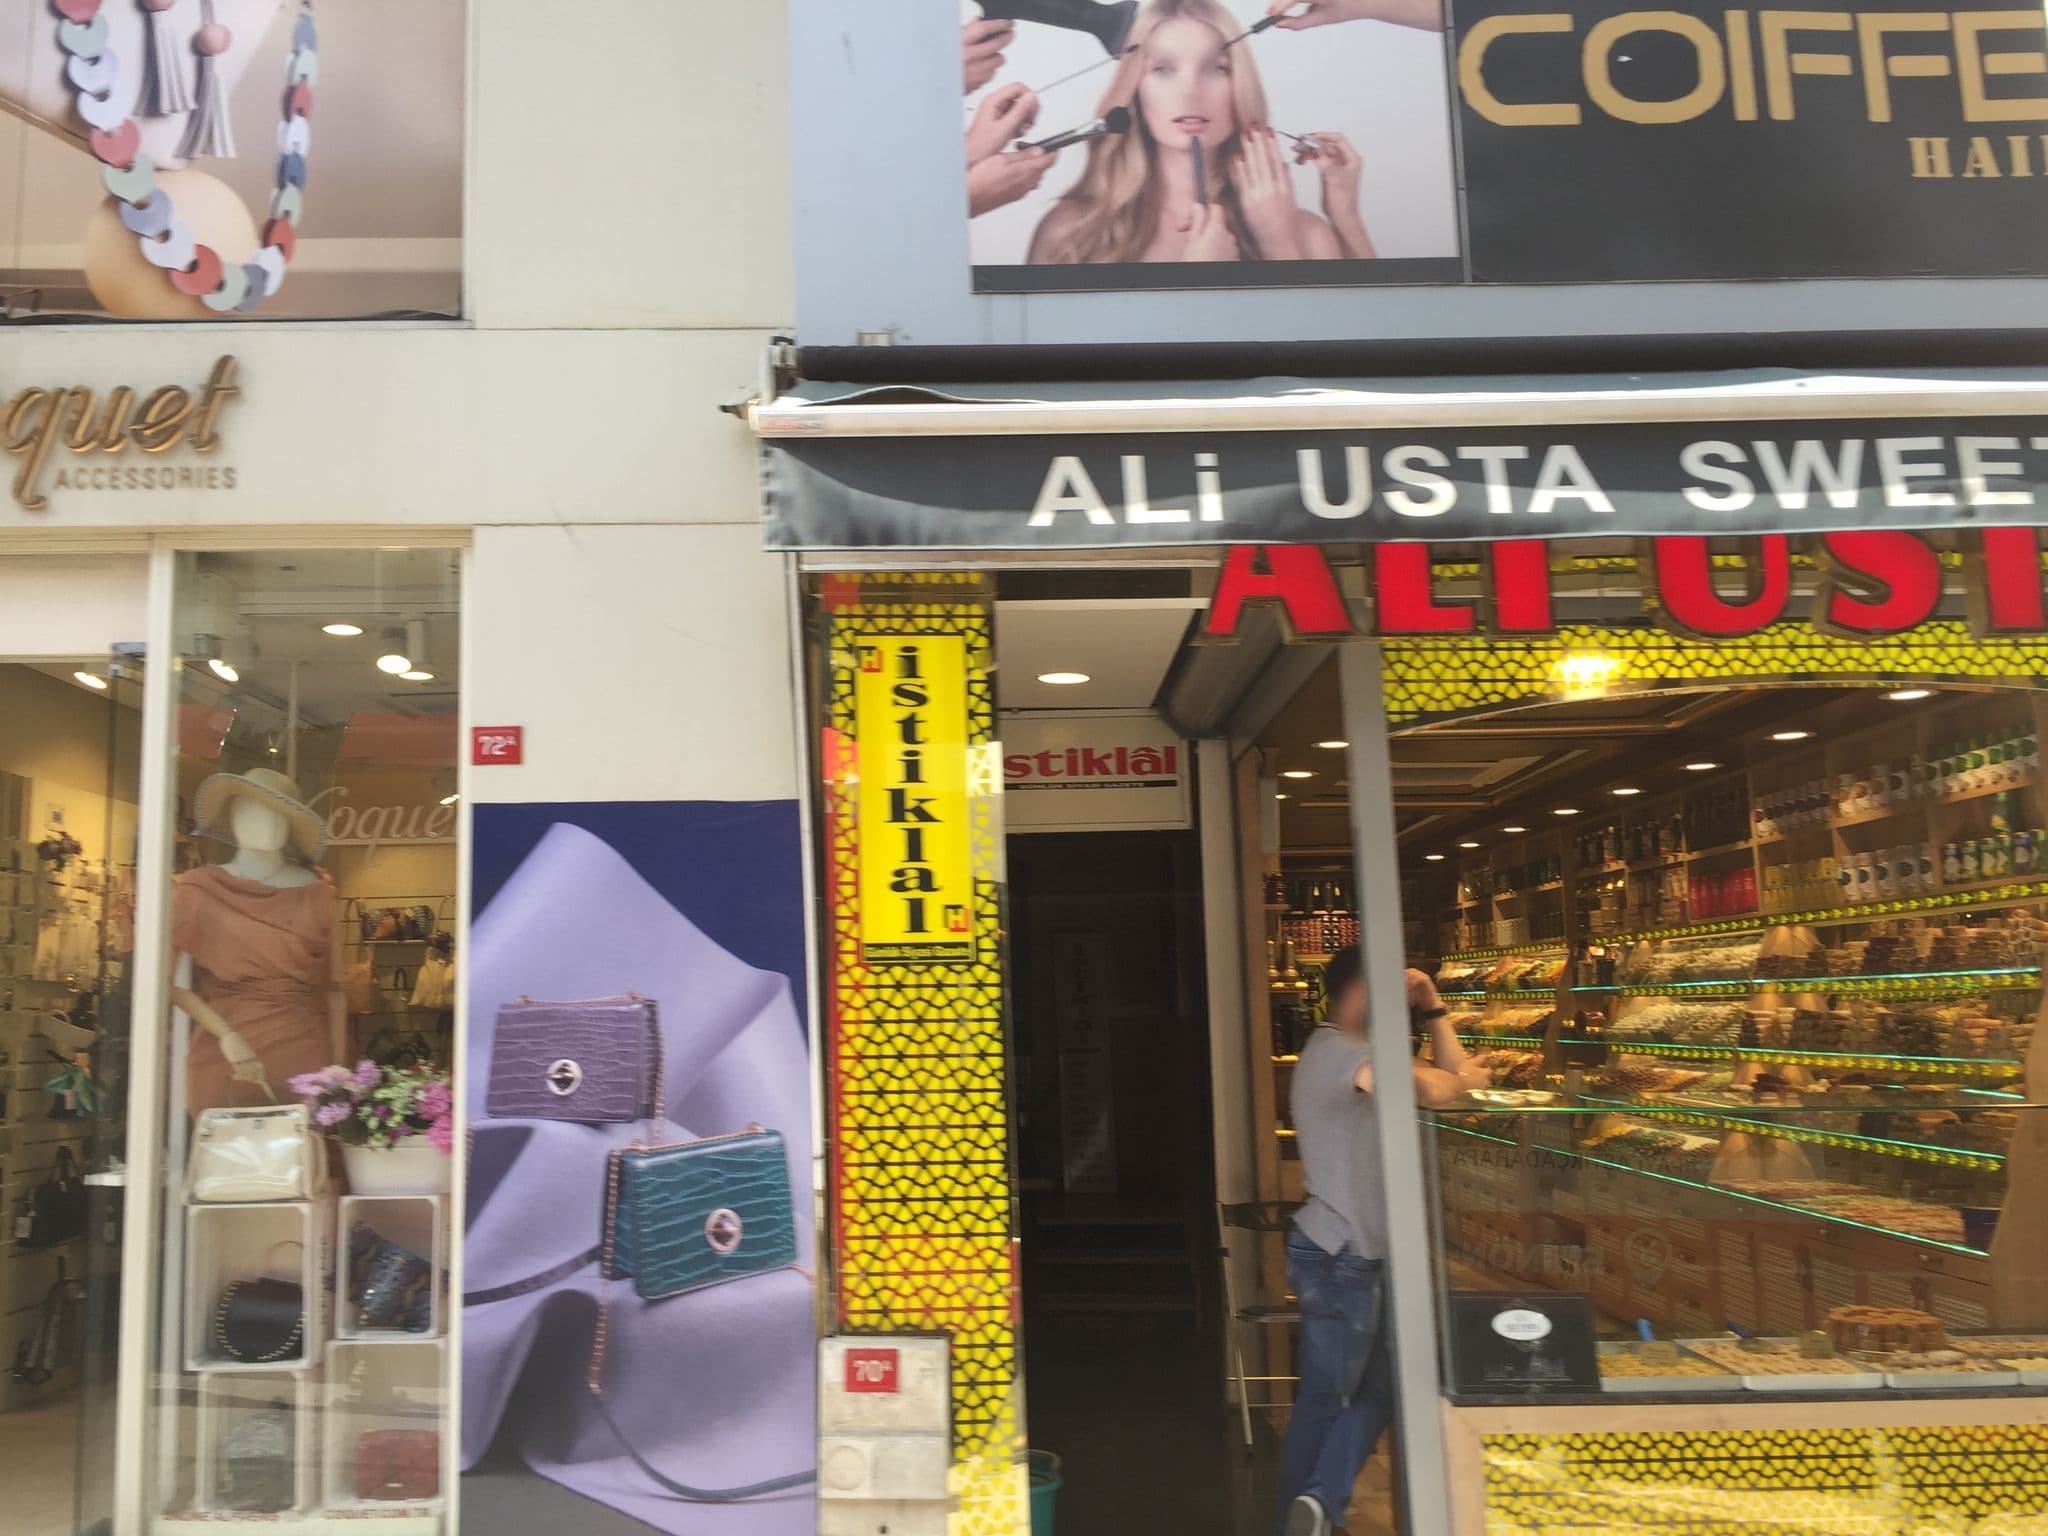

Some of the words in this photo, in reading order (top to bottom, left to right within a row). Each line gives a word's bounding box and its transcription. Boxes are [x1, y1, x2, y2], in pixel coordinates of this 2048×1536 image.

[1458, 10, 2047, 126] COIFFE
[1907, 136, 2048, 178] HAI
[0, 354, 241, 511] quet
[55, 466, 238, 491] ACCESSORIES
[1297, 444, 1616, 520] USTA
[1680, 435, 2048, 512] SWEE
[884, 645, 943, 933] istiklal
